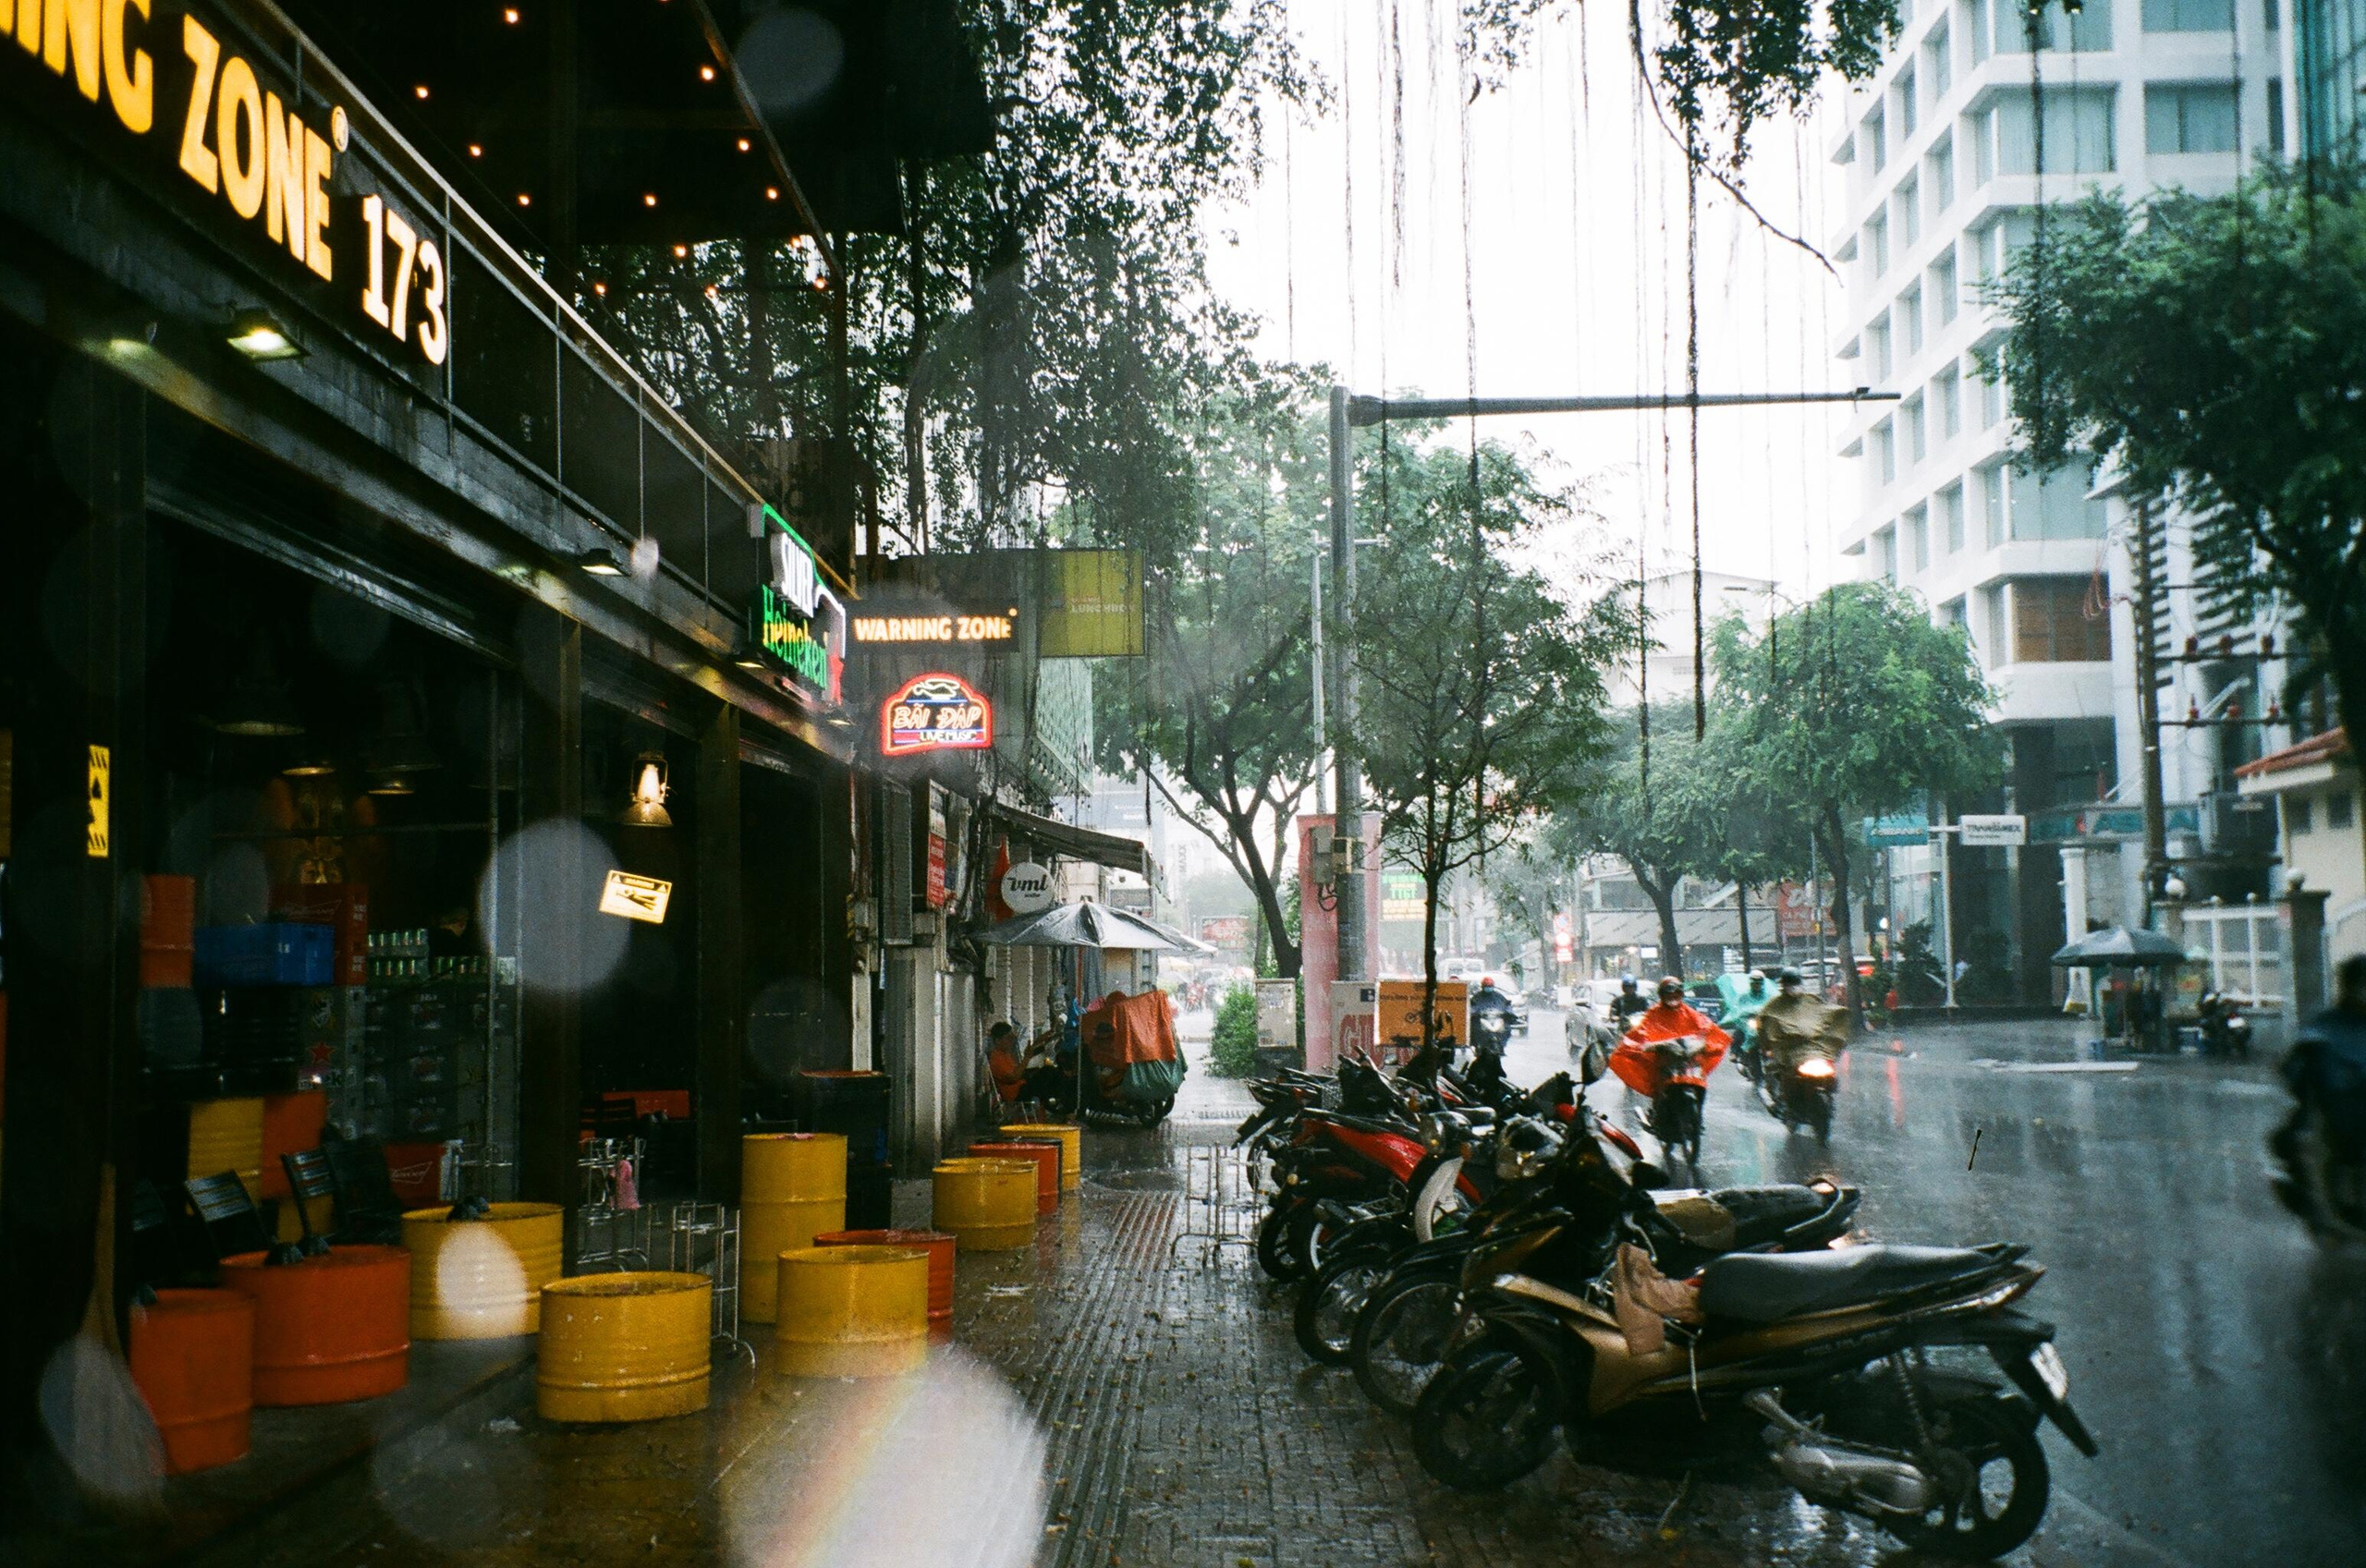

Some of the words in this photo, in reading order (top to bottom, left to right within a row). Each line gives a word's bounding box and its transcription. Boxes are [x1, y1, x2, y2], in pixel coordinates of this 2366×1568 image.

[178, 15, 333, 282] ZONE
[361, 193, 448, 366] 173
[762, 583, 828, 691] Heineken
[854, 617, 952, 641] WARNING
[957, 616, 1012, 640] ZONE
[893, 702, 931, 730] BÃI
[936, 702, 982, 730] ĐÁP
[920, 730, 946, 742] LIVE
[946, 730, 978, 742] MUSIC
